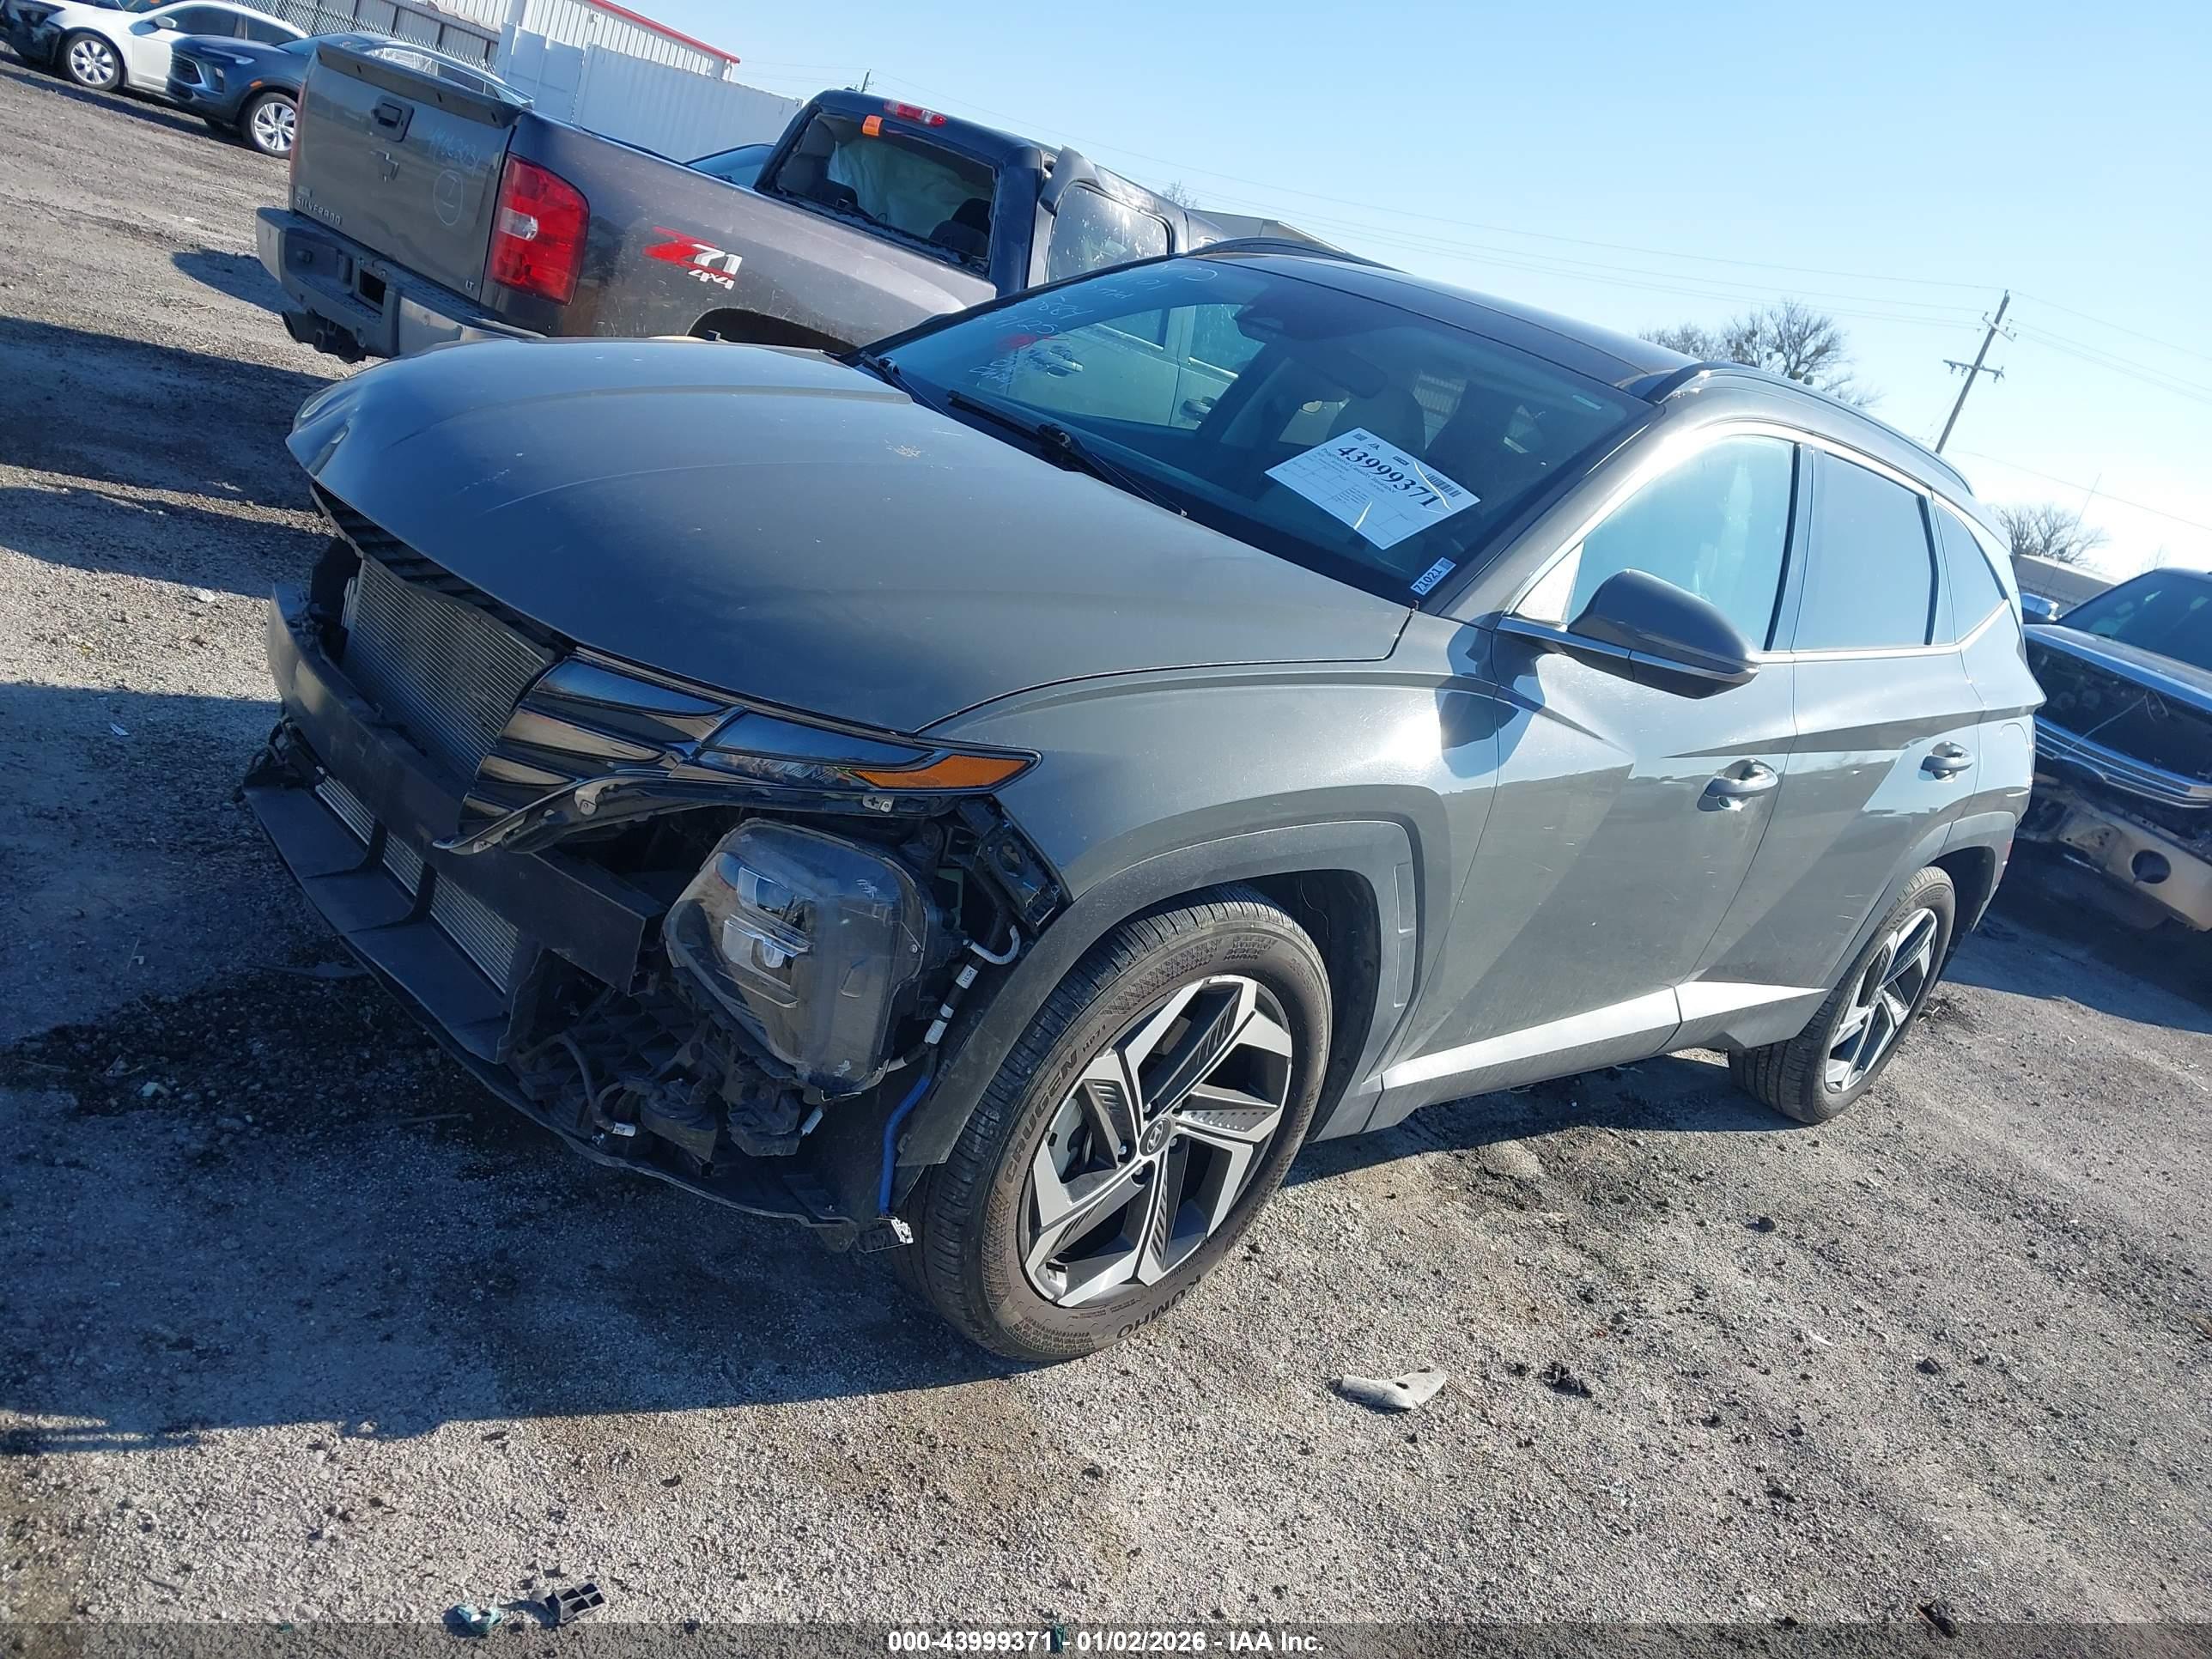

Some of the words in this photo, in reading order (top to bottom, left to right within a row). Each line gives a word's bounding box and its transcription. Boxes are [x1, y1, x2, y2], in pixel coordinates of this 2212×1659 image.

[295, 196, 341, 227] SILVERADO
[1337, 446, 1440, 508] 43999371
[1413, 568, 1443, 592] 71021
[1116, 1273, 1201, 1340] KUMHO
